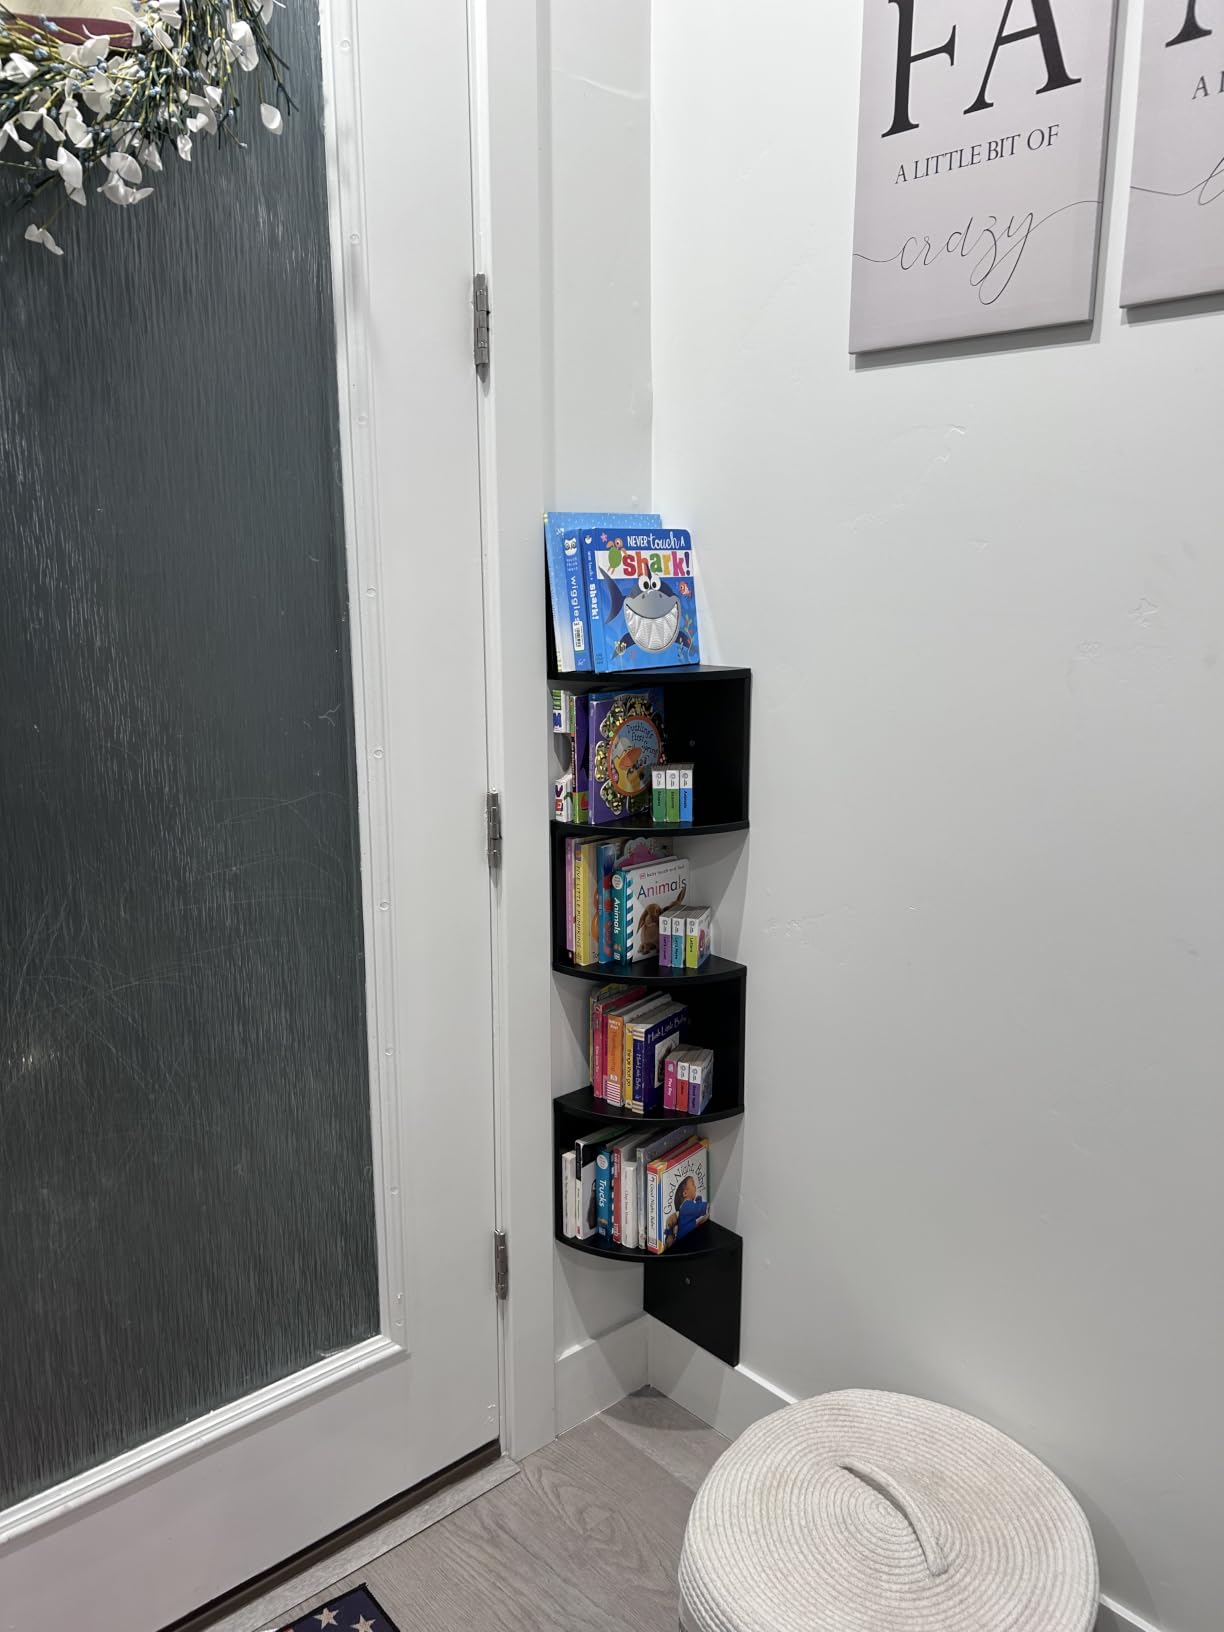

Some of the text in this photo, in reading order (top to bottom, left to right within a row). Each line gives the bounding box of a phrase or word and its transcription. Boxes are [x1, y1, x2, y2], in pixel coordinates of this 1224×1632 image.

[895, 124, 1060, 184] A LITTLE BIT OF
[885, 210, 1050, 305] crazy
[627, 535, 648, 547] NEVER
[649, 531, 680, 550] touch
[622, 551, 691, 577] shark!
[589, 583, 600, 620] shark!
[637, 873, 687, 900] Animals
[599, 1179, 607, 1207] Trucks
[664, 1182, 676, 1215] Good
